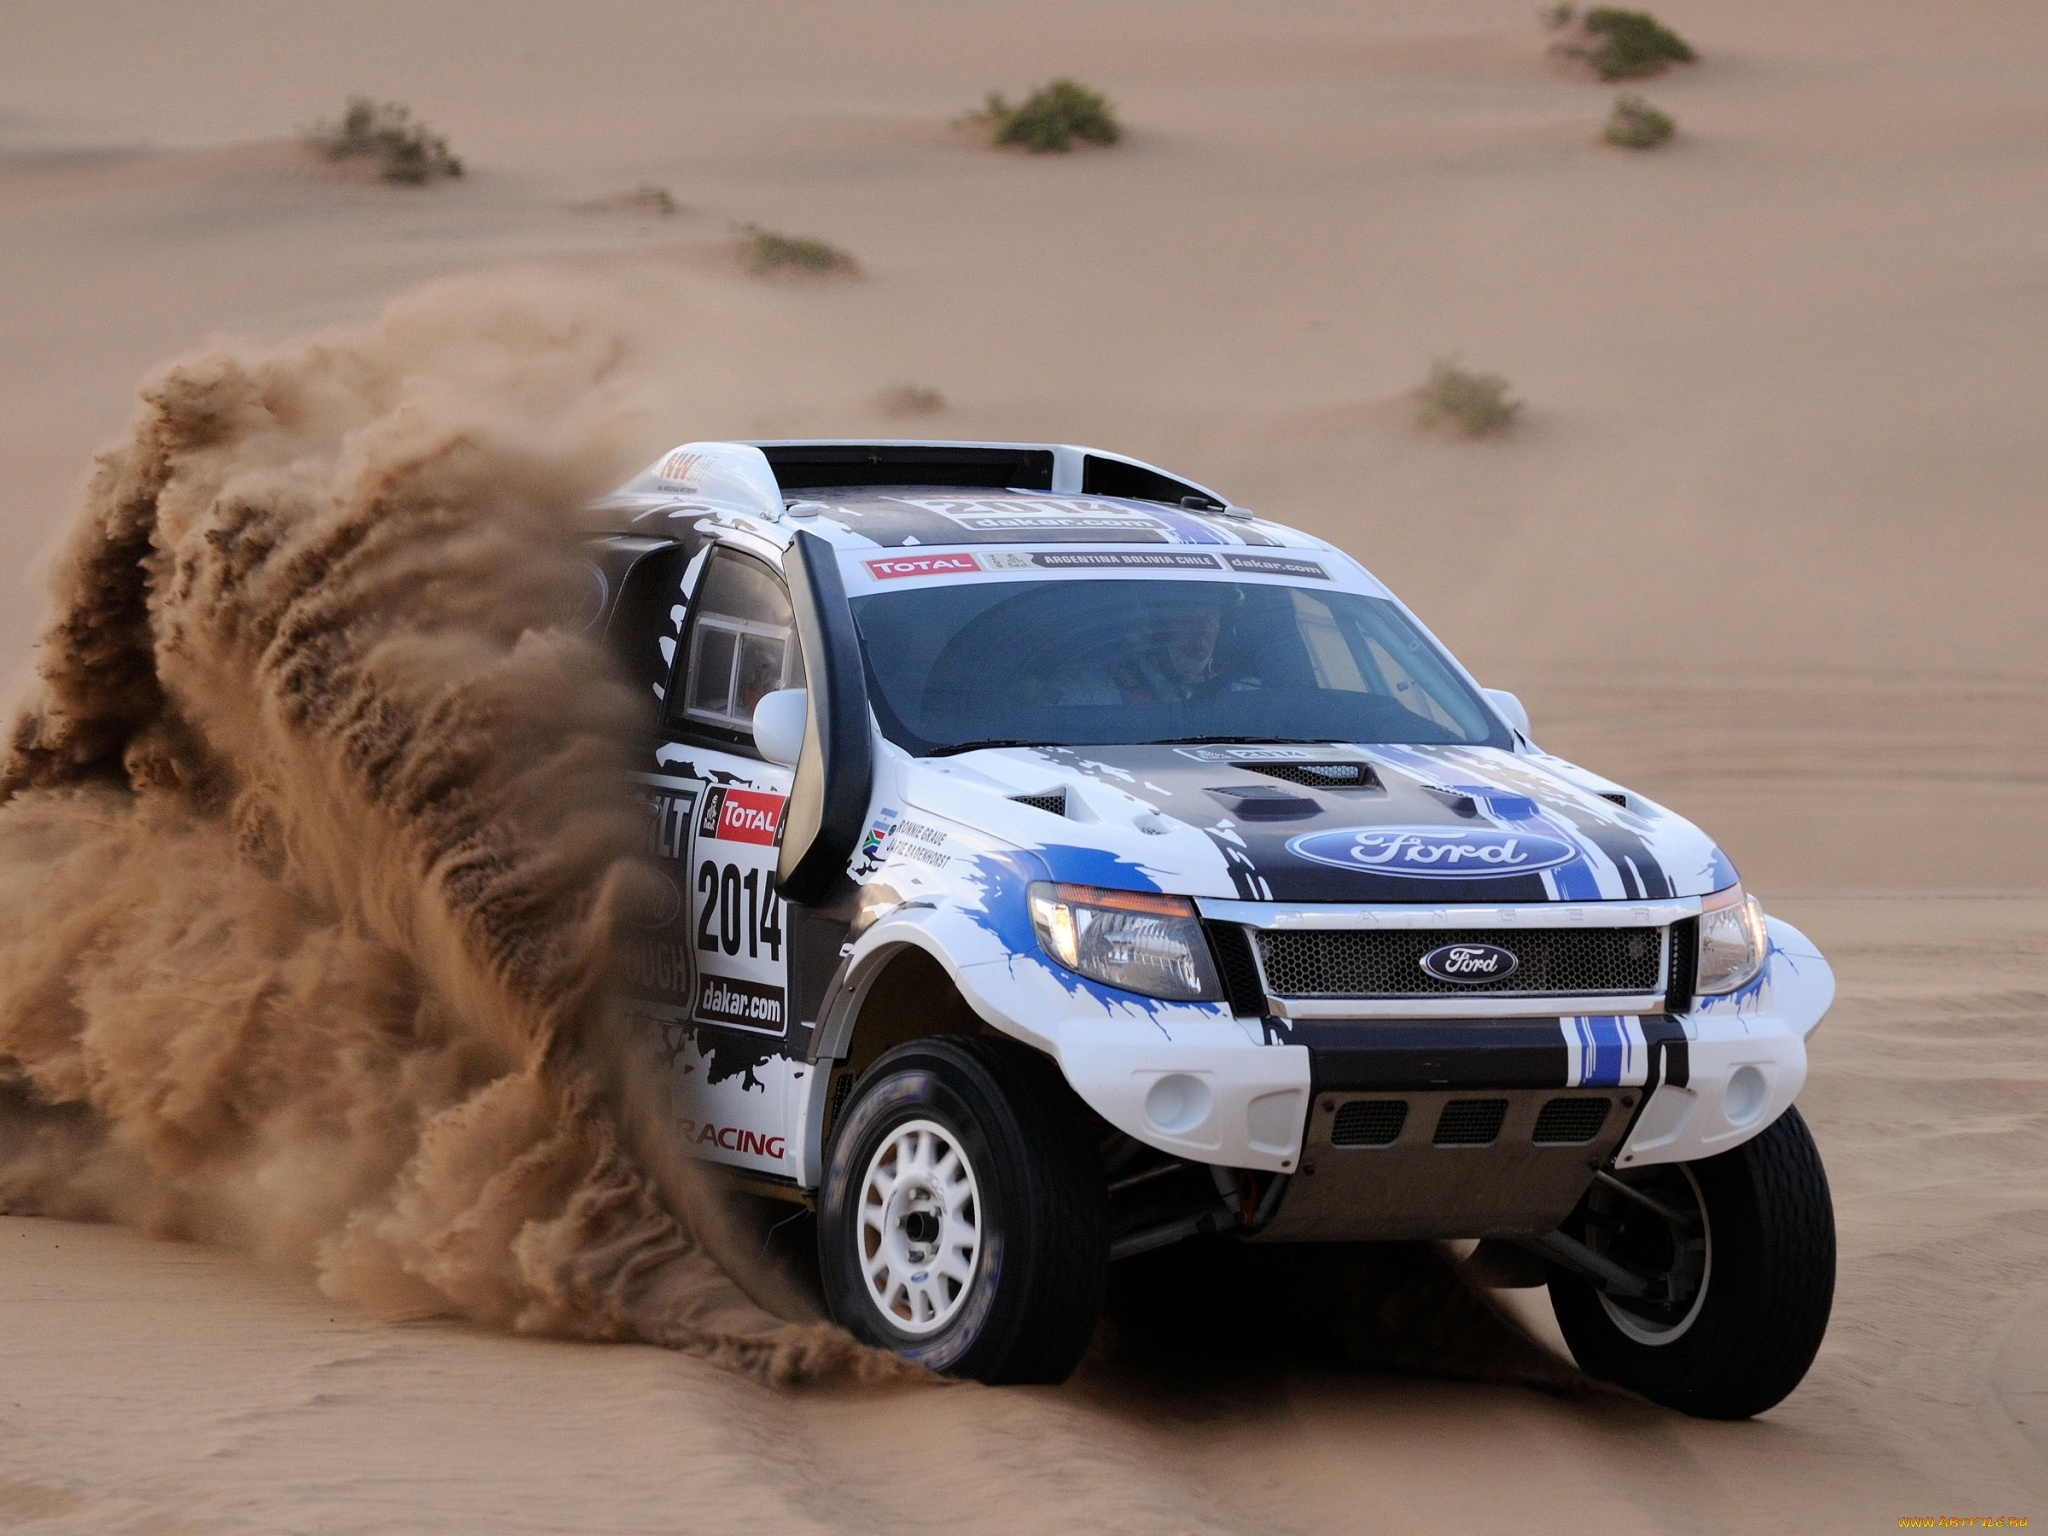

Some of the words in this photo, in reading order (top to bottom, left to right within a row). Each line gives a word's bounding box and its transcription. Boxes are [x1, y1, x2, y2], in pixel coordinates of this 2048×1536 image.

[925, 500, 1131, 515] 2014
[976, 517, 1154, 528] dakar.com
[872, 559, 972, 574] TOTAL
[1044, 555, 1120, 565] ARGENTINA
[1123, 555, 1174, 565] BOLIVIA
[1175, 556, 1214, 565] CHILE
[1231, 558, 1321, 574] dakar.com
[725, 800, 775, 832] TOTAL
[896, 820, 924, 839] RONNIE
[920, 826, 947, 847] GRAUE
[886, 839, 908, 856] JAPIE
[904, 844, 951, 868] BADENHORST
[1350, 831, 1528, 864] Ford
[698, 860, 782, 962] 2014
[1445, 948, 1498, 973] Ford
[703, 981, 781, 1022] dakar.com
